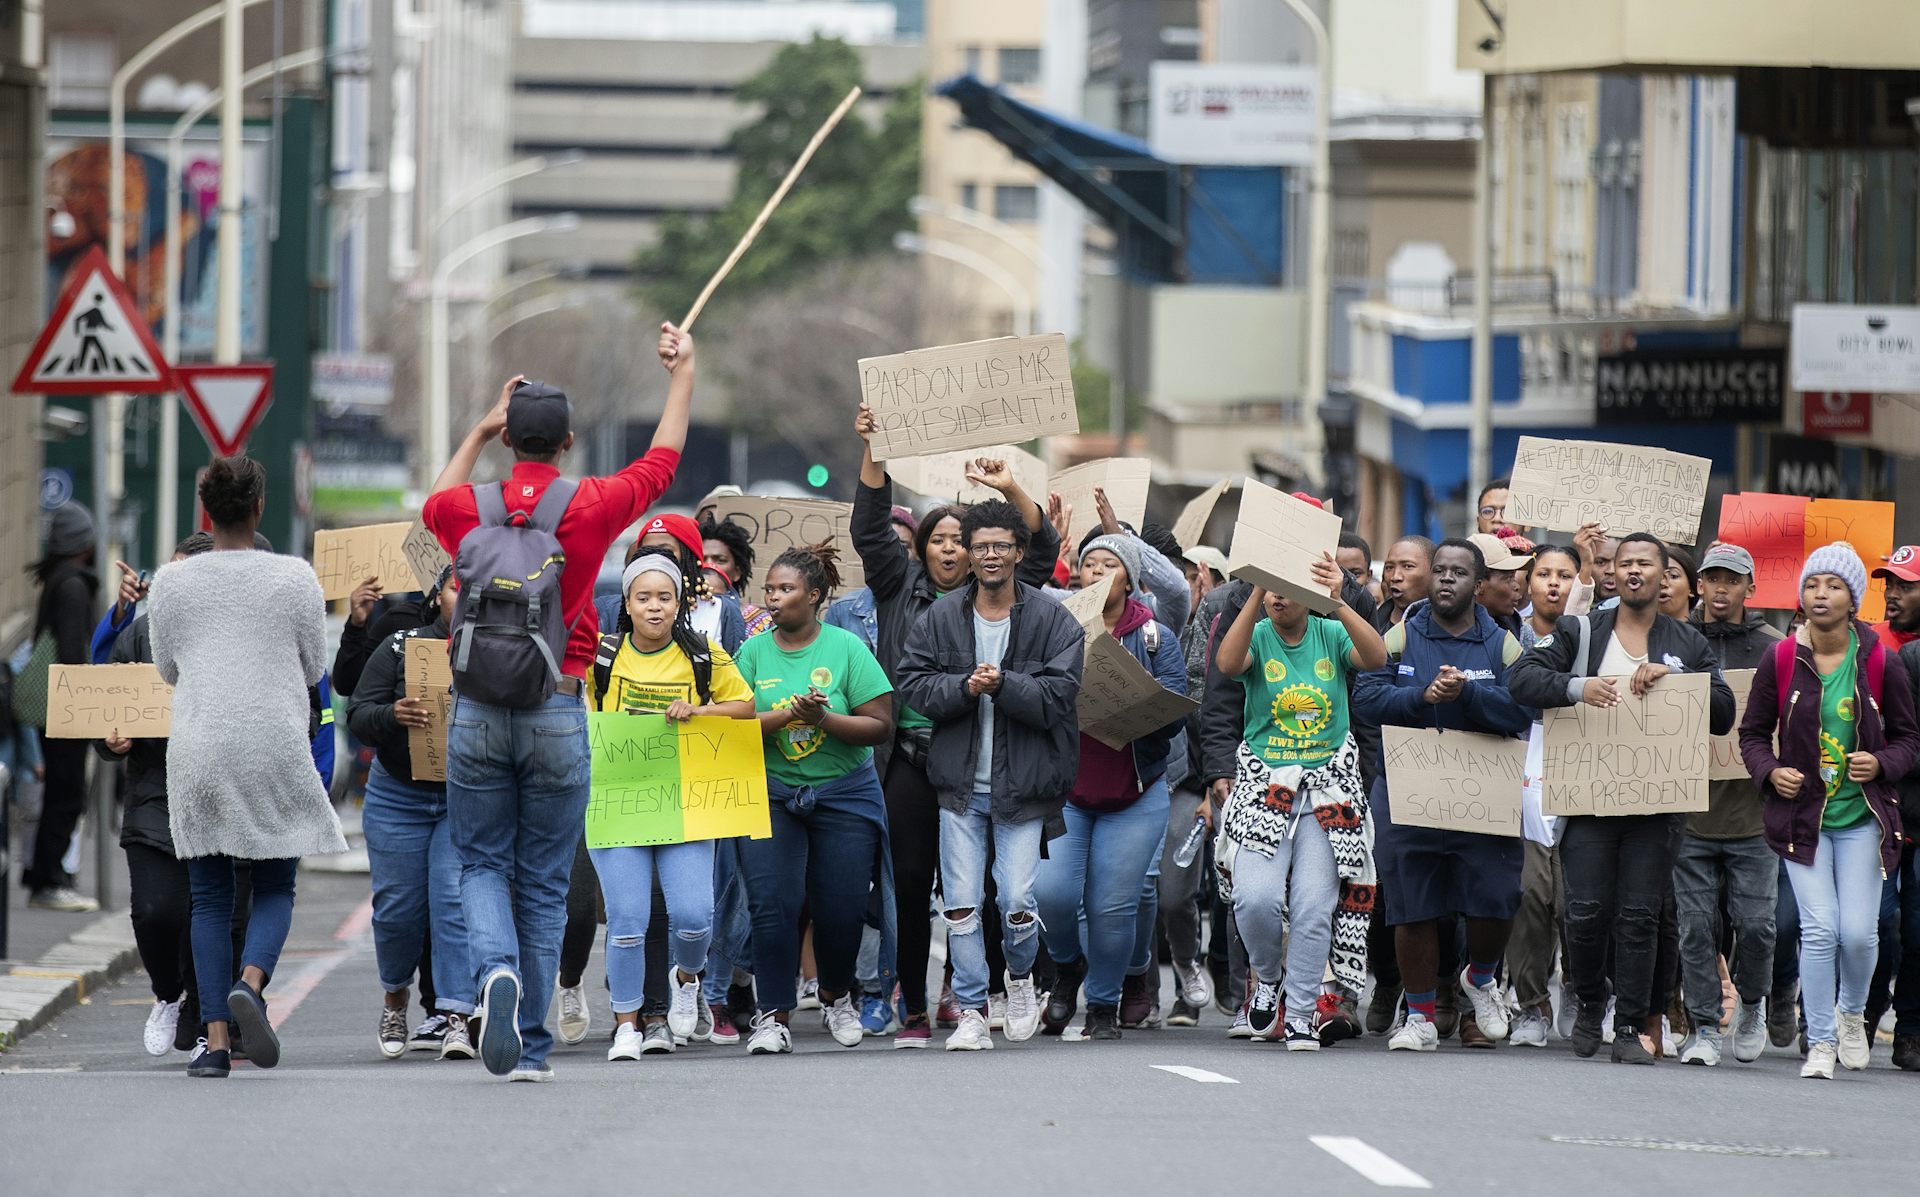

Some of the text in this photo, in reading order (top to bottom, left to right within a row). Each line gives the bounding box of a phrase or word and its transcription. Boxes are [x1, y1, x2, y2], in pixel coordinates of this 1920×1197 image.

[865, 346, 1055, 408] PARDON US MR
[1600, 361, 1779, 391] NANNUCCI
[1600, 390, 1780, 408] DRY CLEANERS
[1519, 445, 1704, 497] #THUMUMINA
[1561, 475, 1703, 522] TO SCHOOL
[1513, 493, 1697, 545] NOT PRISON
[1722, 501, 1855, 541] AMNESTY
[56, 670, 139, 701] Amnesty
[414, 644, 435, 703] Criminal
[591, 721, 725, 763] AMNESTY
[1543, 741, 1672, 780] #PARDON
[1678, 742, 1708, 776] US
[587, 777, 760, 823] #FEESMUSTFALL
[1440, 778, 1482, 797] TO
[1591, 779, 1704, 811] PRESIDENT
[1406, 793, 1508, 824] SCHOOL
